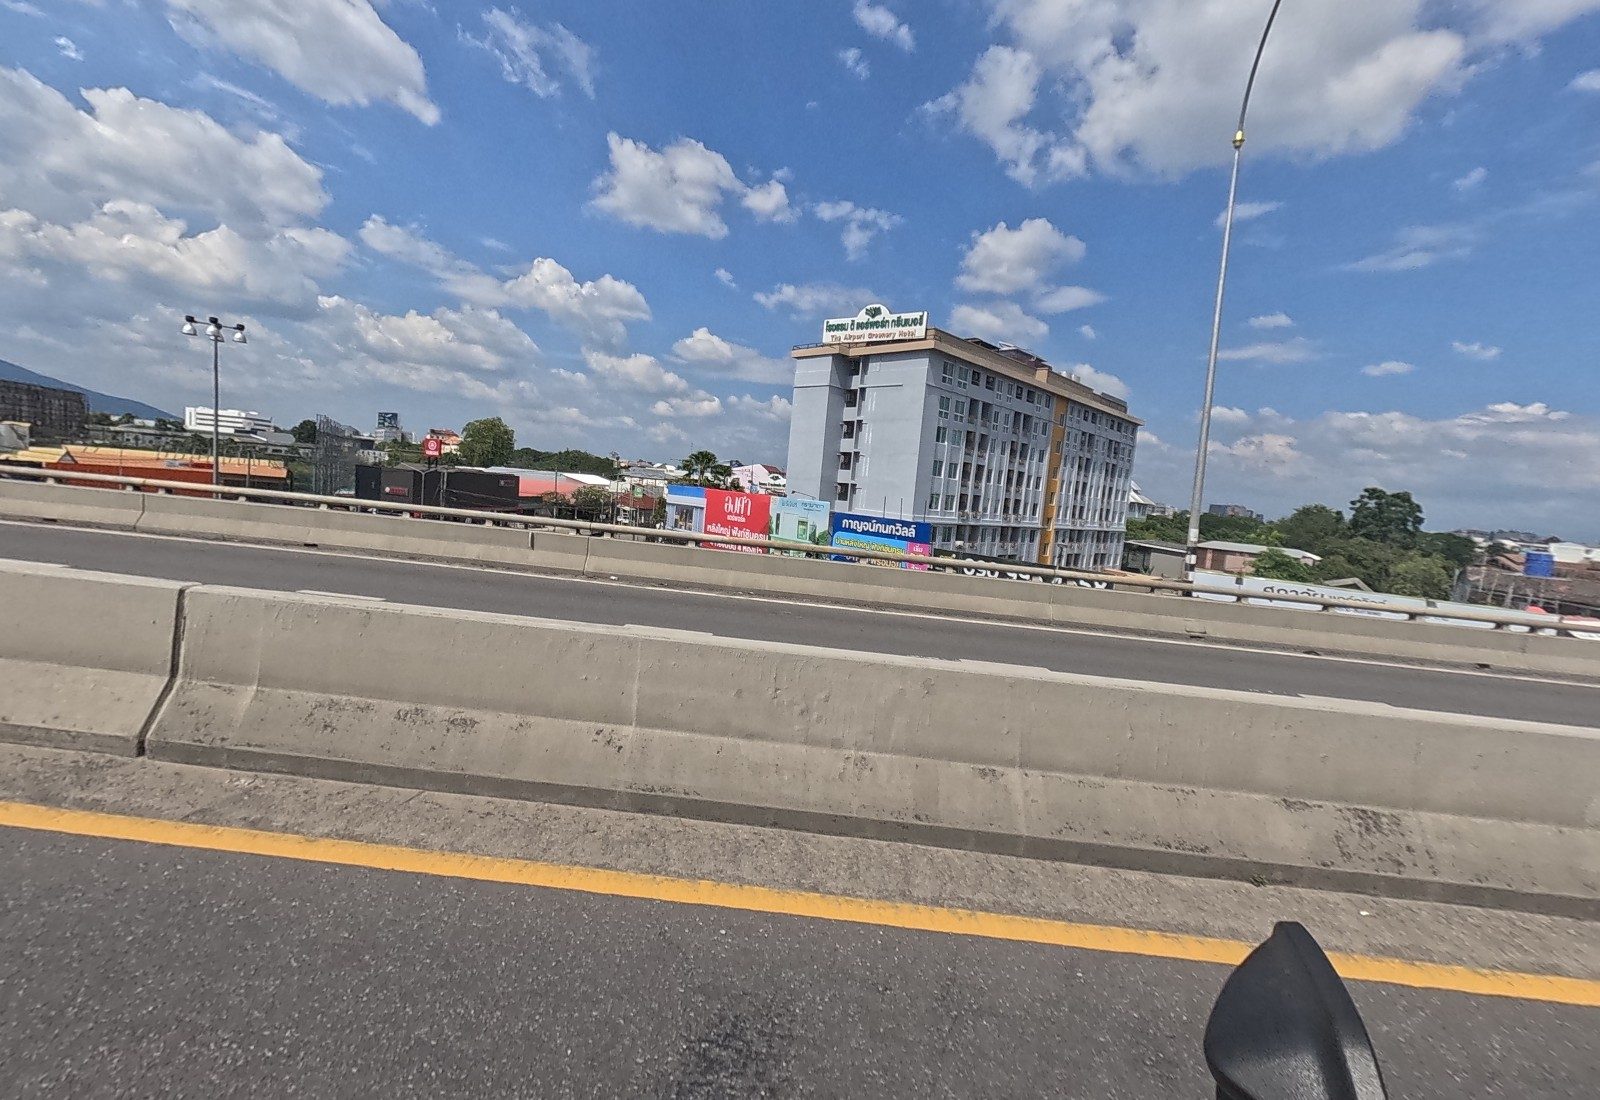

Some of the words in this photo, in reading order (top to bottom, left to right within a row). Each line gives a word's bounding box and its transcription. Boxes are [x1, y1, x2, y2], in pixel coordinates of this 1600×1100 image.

[830, 334, 841, 342] The
[843, 333, 865, 342] Airport
[898, 329, 916, 338] Hotel
